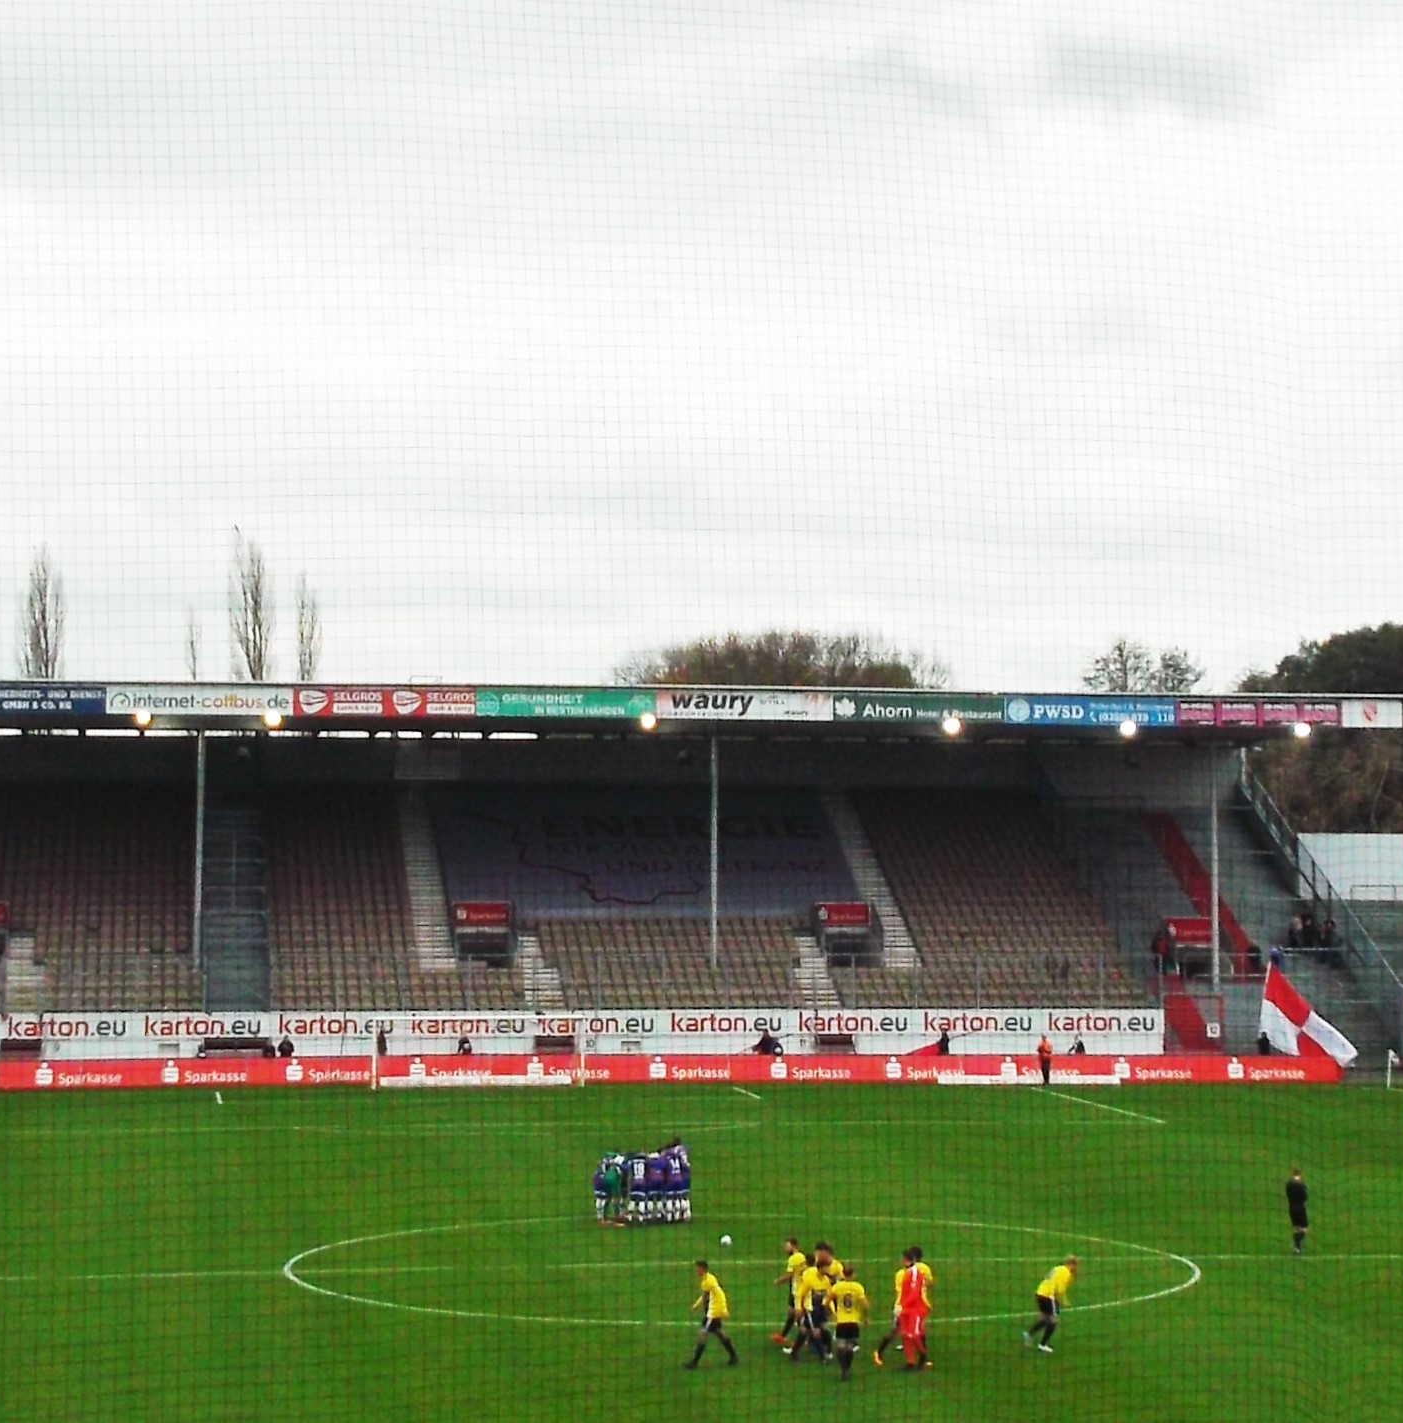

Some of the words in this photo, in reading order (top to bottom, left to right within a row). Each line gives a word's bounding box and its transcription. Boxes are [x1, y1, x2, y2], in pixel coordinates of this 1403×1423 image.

[333, 691, 382, 702] SELGROS
[426, 691, 475, 702] SELGROS
[502, 693, 583, 704] GESUNDHEIT
[672, 693, 755, 716] waury
[863, 703, 913, 718] Ahorn
[1033, 704, 1084, 719] PWSD
[8, 1016, 127, 1037] karton.eu
[144, 1015, 261, 1037] karton.eu
[670, 1013, 782, 1032] karton.eu
[798, 1013, 908, 1032] karton.eu
[924, 1011, 1032, 1032] karton.eu
[1048, 1011, 1156, 1031] karton.eu
[58, 1072, 122, 1086] Sparkasse
[184, 1069, 247, 1084] Sparkasse
[308, 1067, 371, 1082] Sparkasse
[671, 1065, 730, 1080] Sparkasse
[792, 1065, 851, 1080] Sparkasse
[1135, 1066, 1192, 1081] Sparkasse
[1250, 1066, 1305, 1081] Sparkasse
